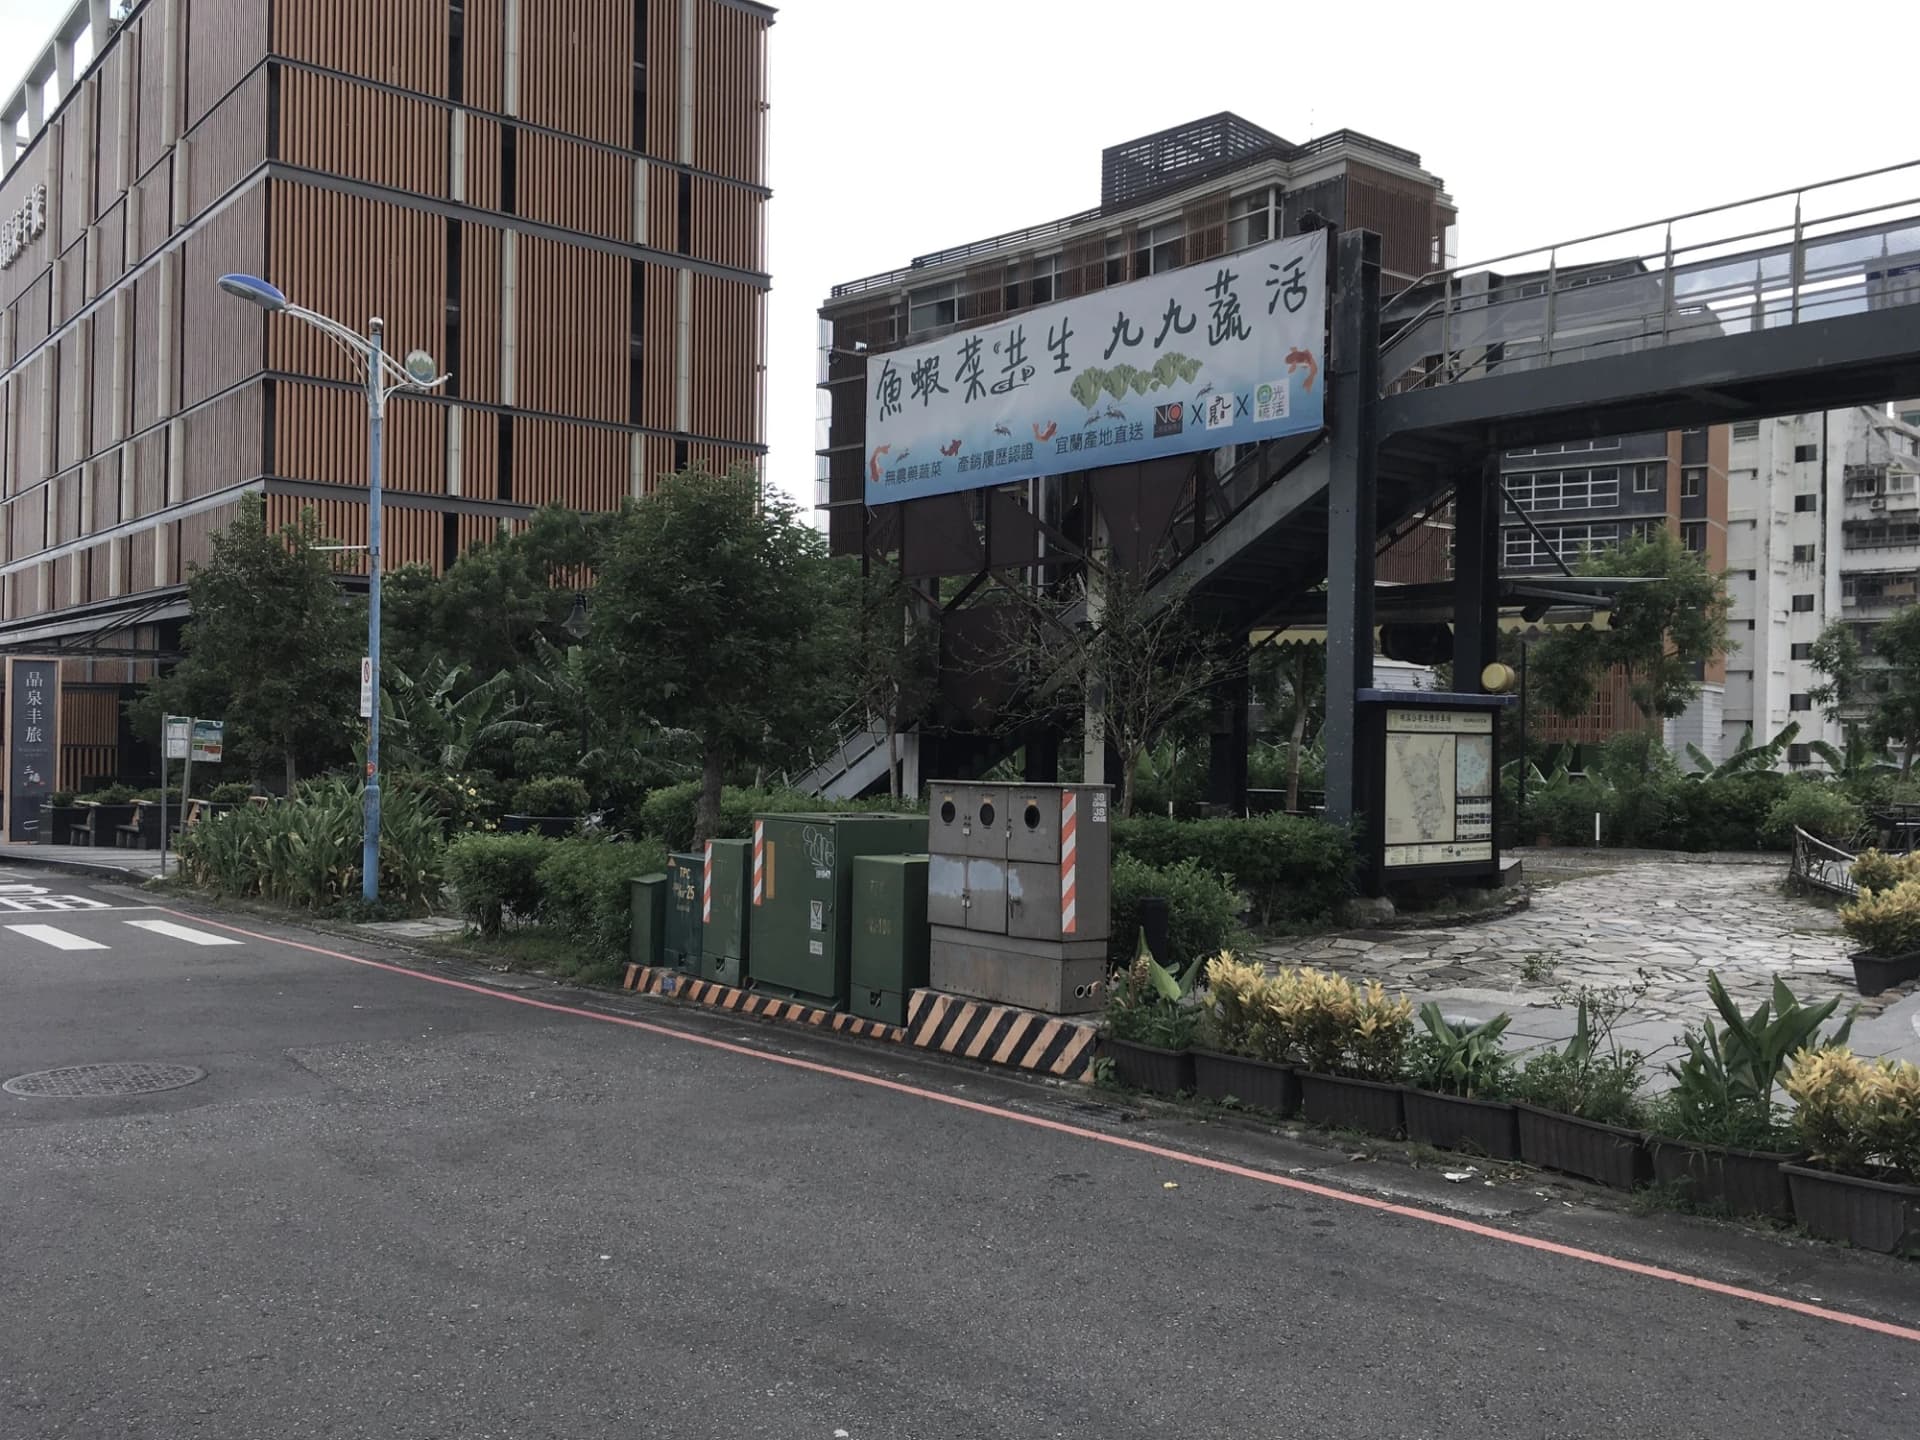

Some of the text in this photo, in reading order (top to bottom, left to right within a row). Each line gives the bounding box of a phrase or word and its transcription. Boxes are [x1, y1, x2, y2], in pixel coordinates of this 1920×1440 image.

[1055, 423, 1144, 455] 宜蘭產地直送
